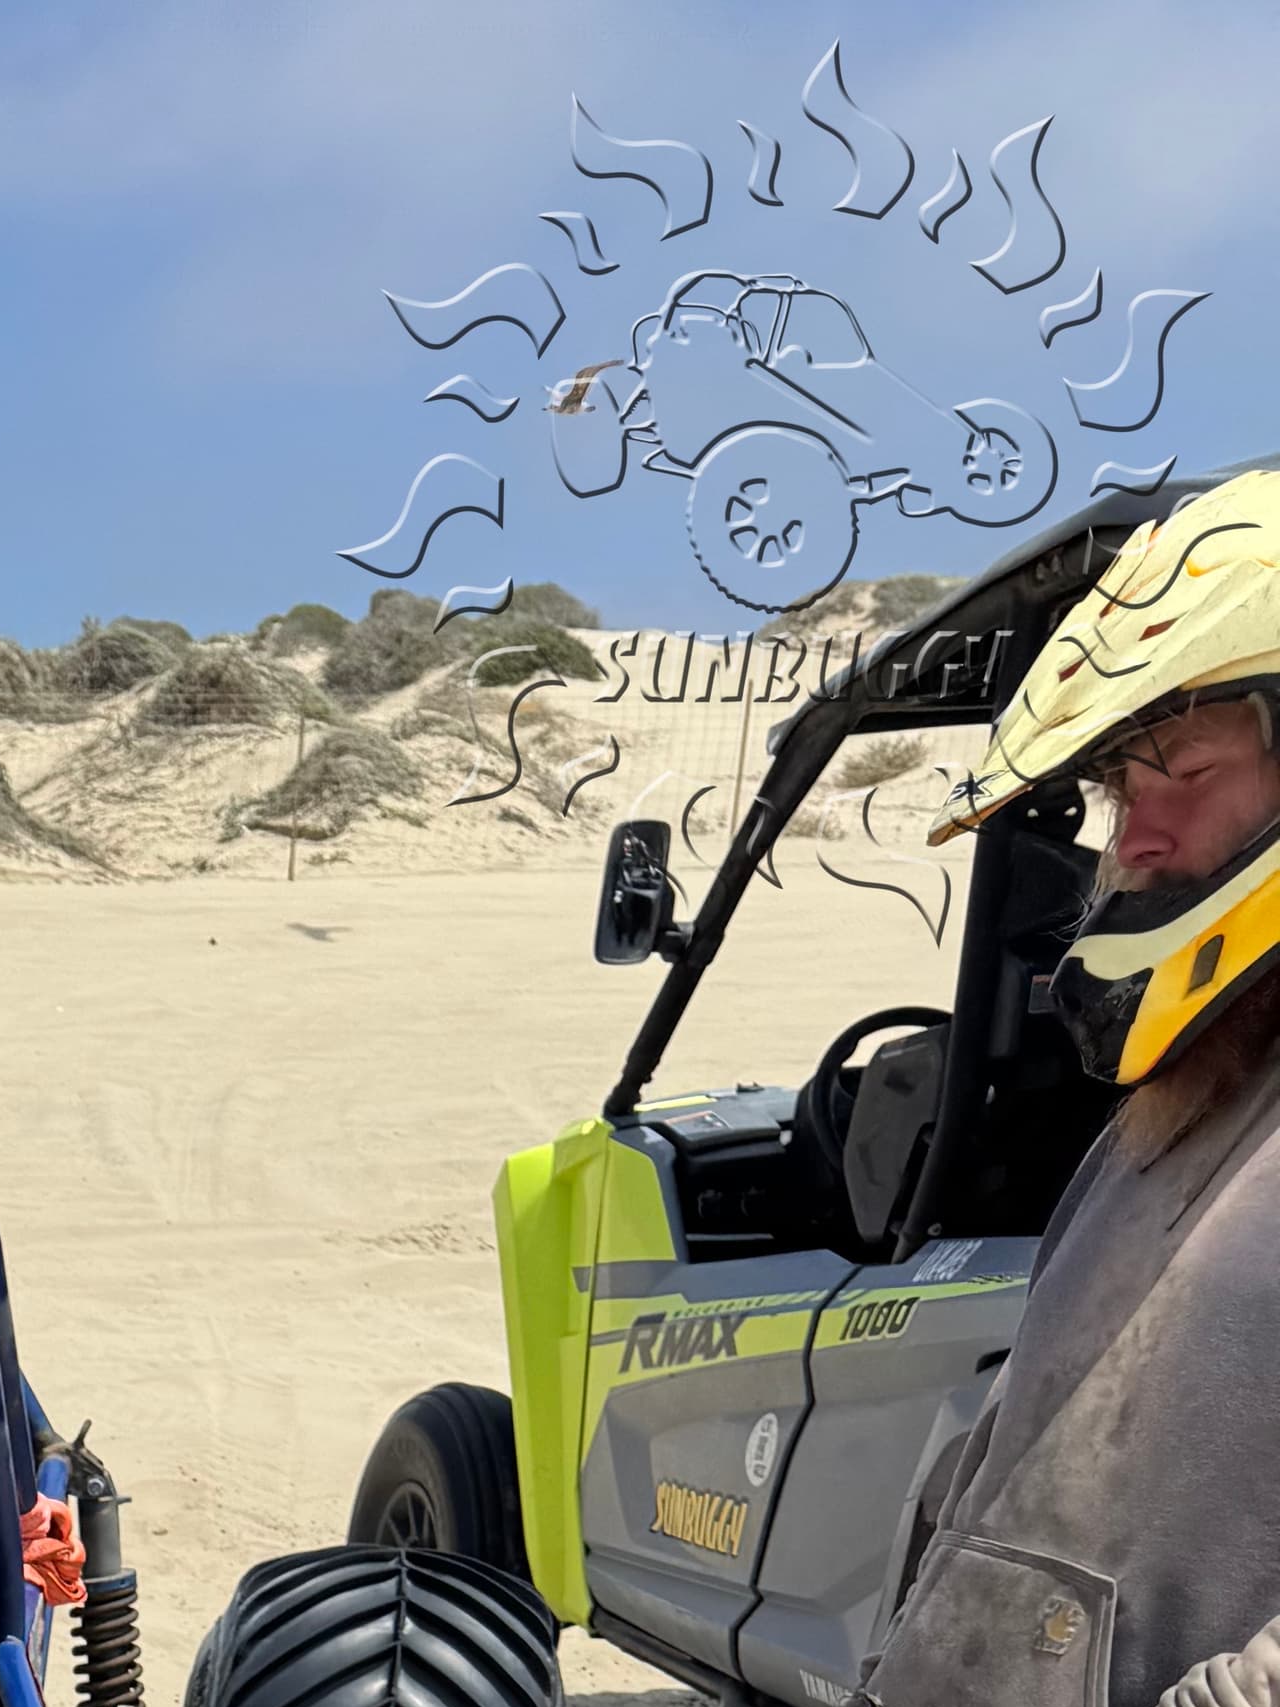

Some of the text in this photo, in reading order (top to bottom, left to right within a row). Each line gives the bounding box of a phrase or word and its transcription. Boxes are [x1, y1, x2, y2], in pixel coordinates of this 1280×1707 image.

[618, 1311, 748, 1374] RMAX
[840, 1296, 921, 1341] 1000
[650, 1481, 748, 1557] SUNBUGGY
[799, 1667, 848, 1707] YAMAH
